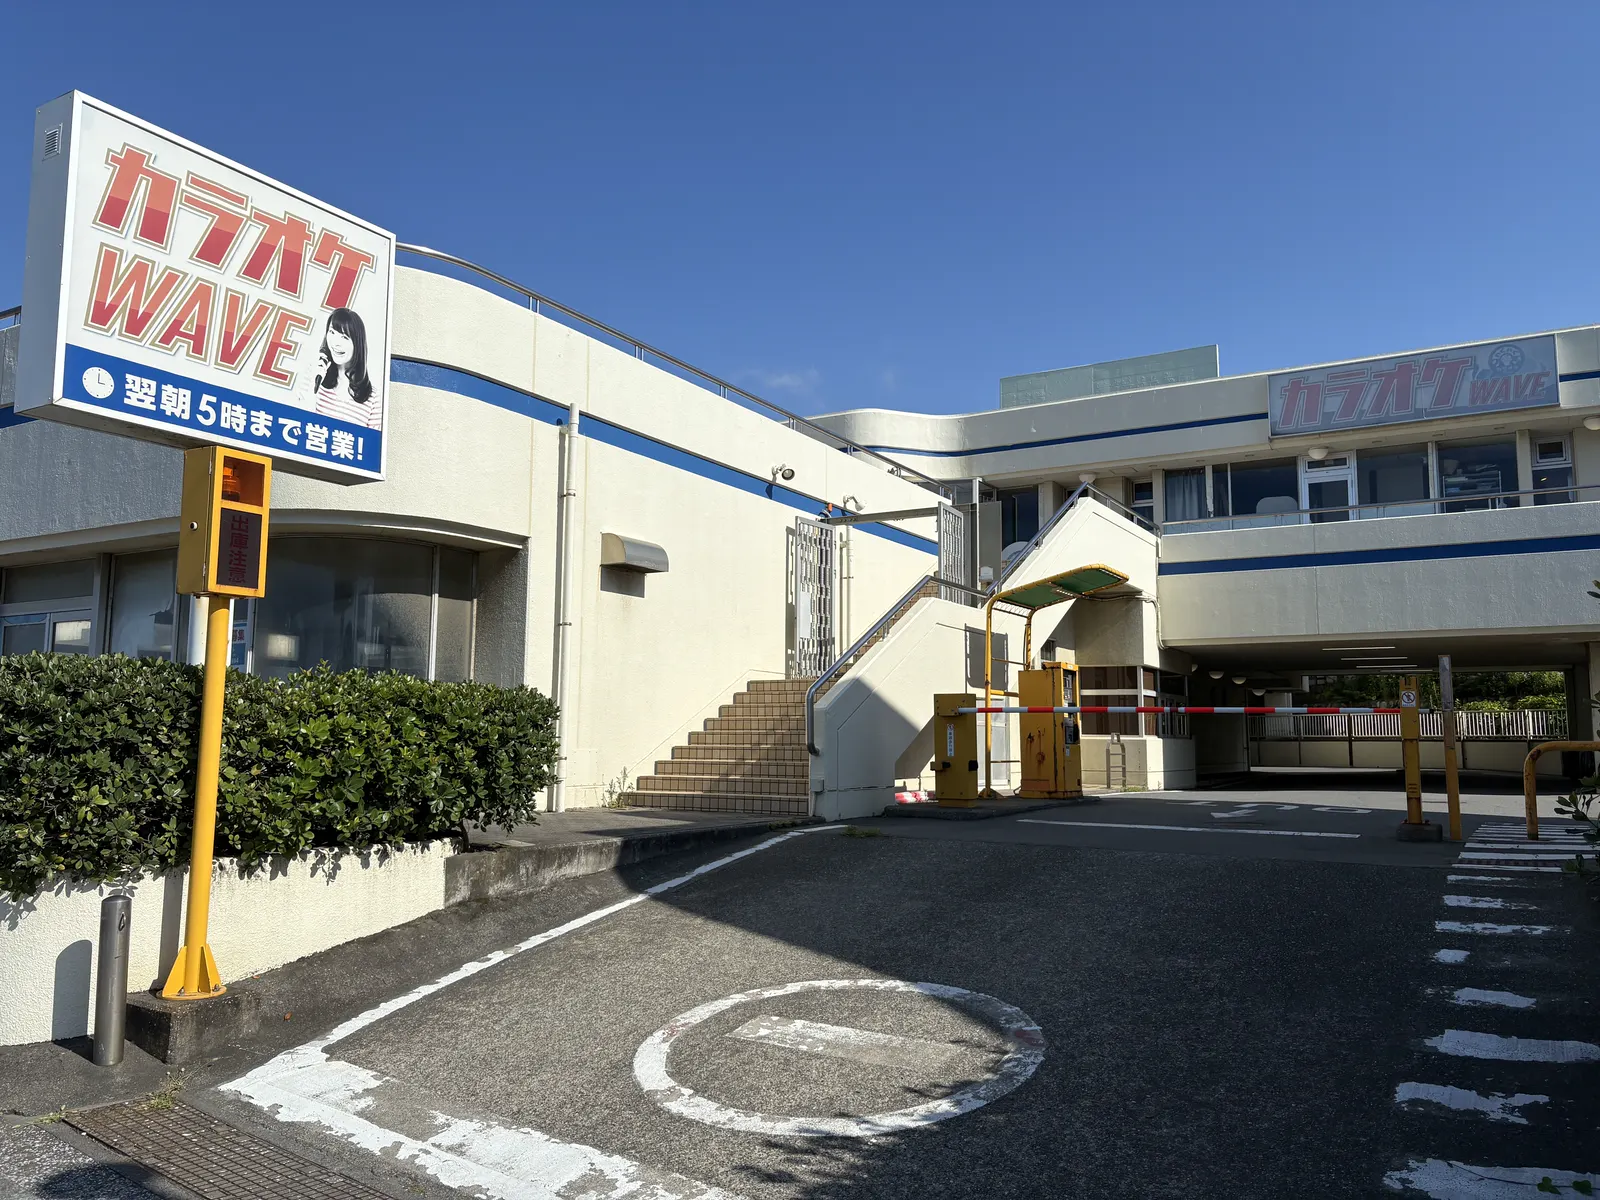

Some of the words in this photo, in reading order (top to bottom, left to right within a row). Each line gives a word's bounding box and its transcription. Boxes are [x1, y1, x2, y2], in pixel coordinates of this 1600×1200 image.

[94, 143, 377, 310] カラオケ
[84, 242, 314, 388] WAVE
[124, 372, 364, 461] 翌朝5時まで営業!
[1278, 357, 1474, 429] カラオケ
[1468, 371, 1551, 406] WAVE
[228, 514, 249, 584] 出庫注意
